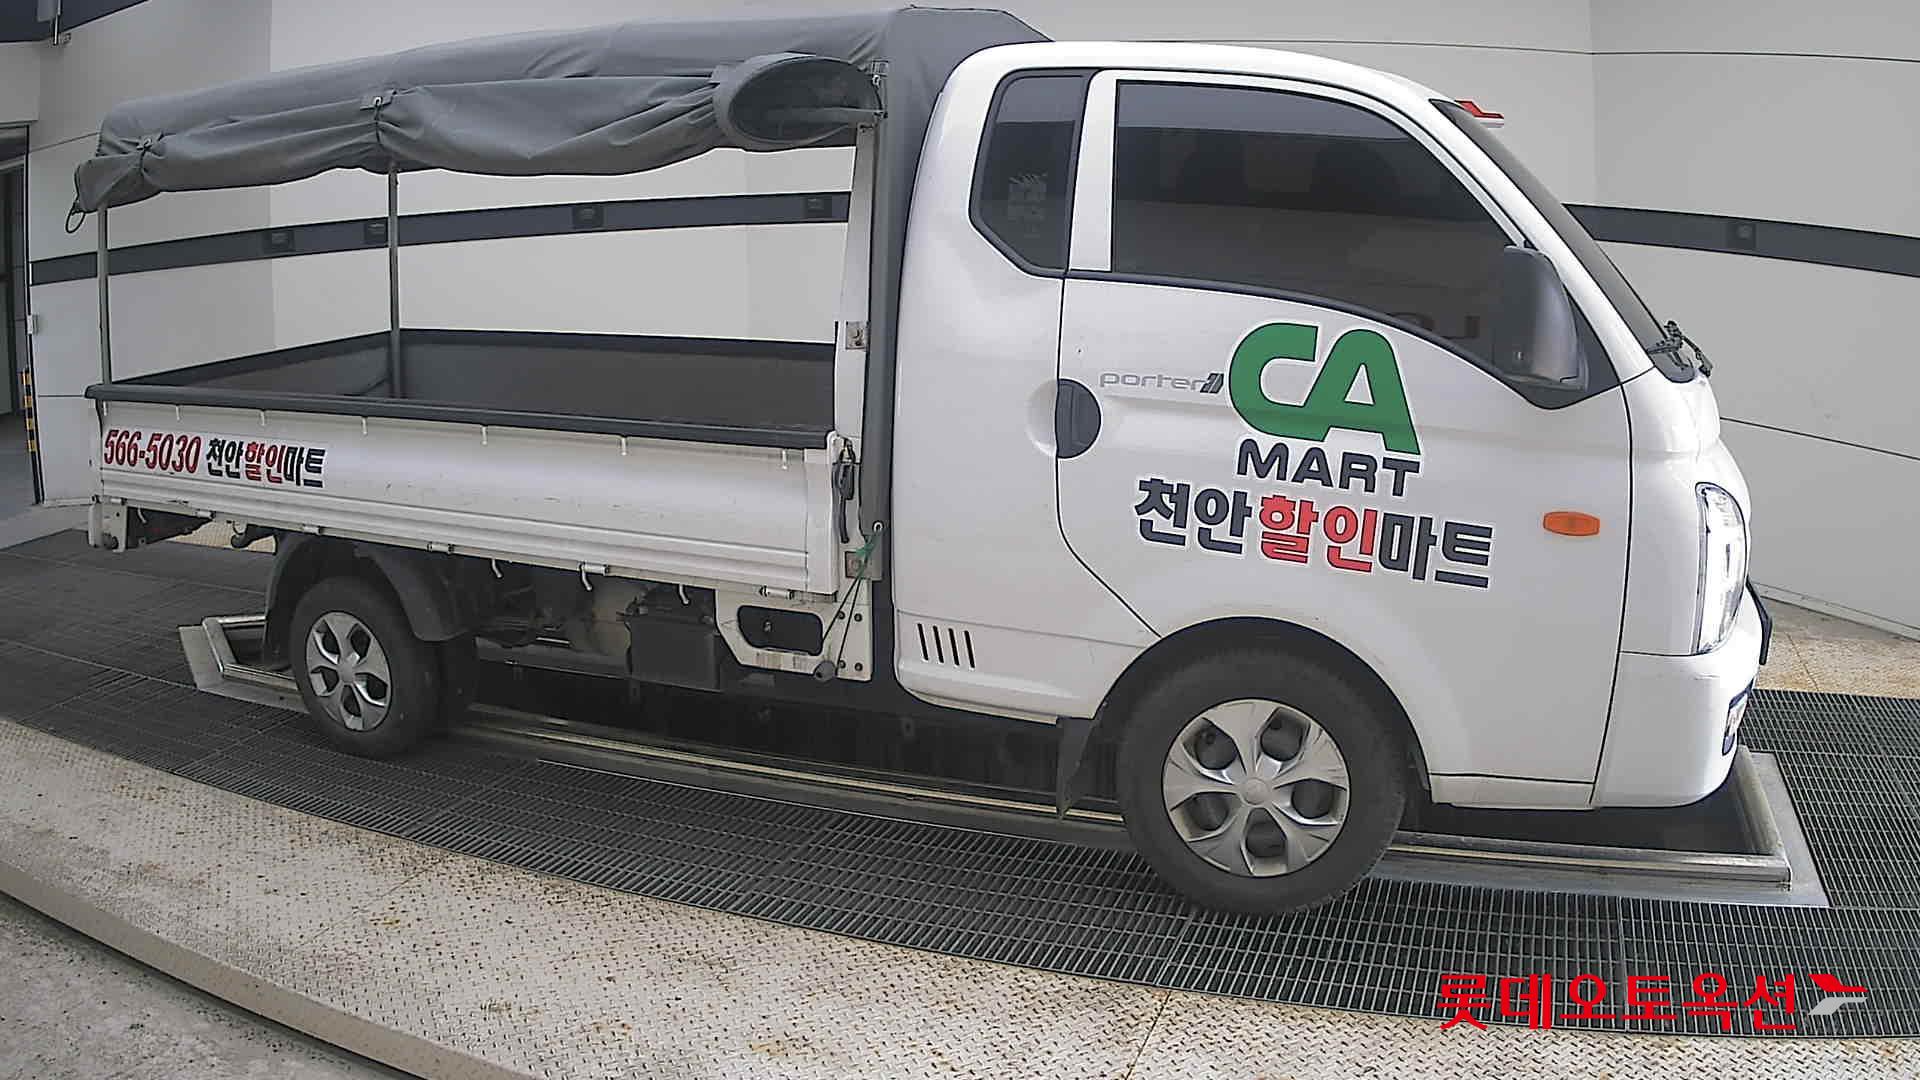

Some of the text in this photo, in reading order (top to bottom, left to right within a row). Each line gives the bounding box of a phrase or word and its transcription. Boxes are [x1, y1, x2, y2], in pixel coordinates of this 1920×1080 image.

[1099, 372, 1206, 391] porter
[1229, 321, 1421, 456] CA
[103, 429, 326, 489] 566-5030 천안할인마트
[1237, 437, 1420, 498] MART
[1134, 477, 1494, 589] 천안할인마트
